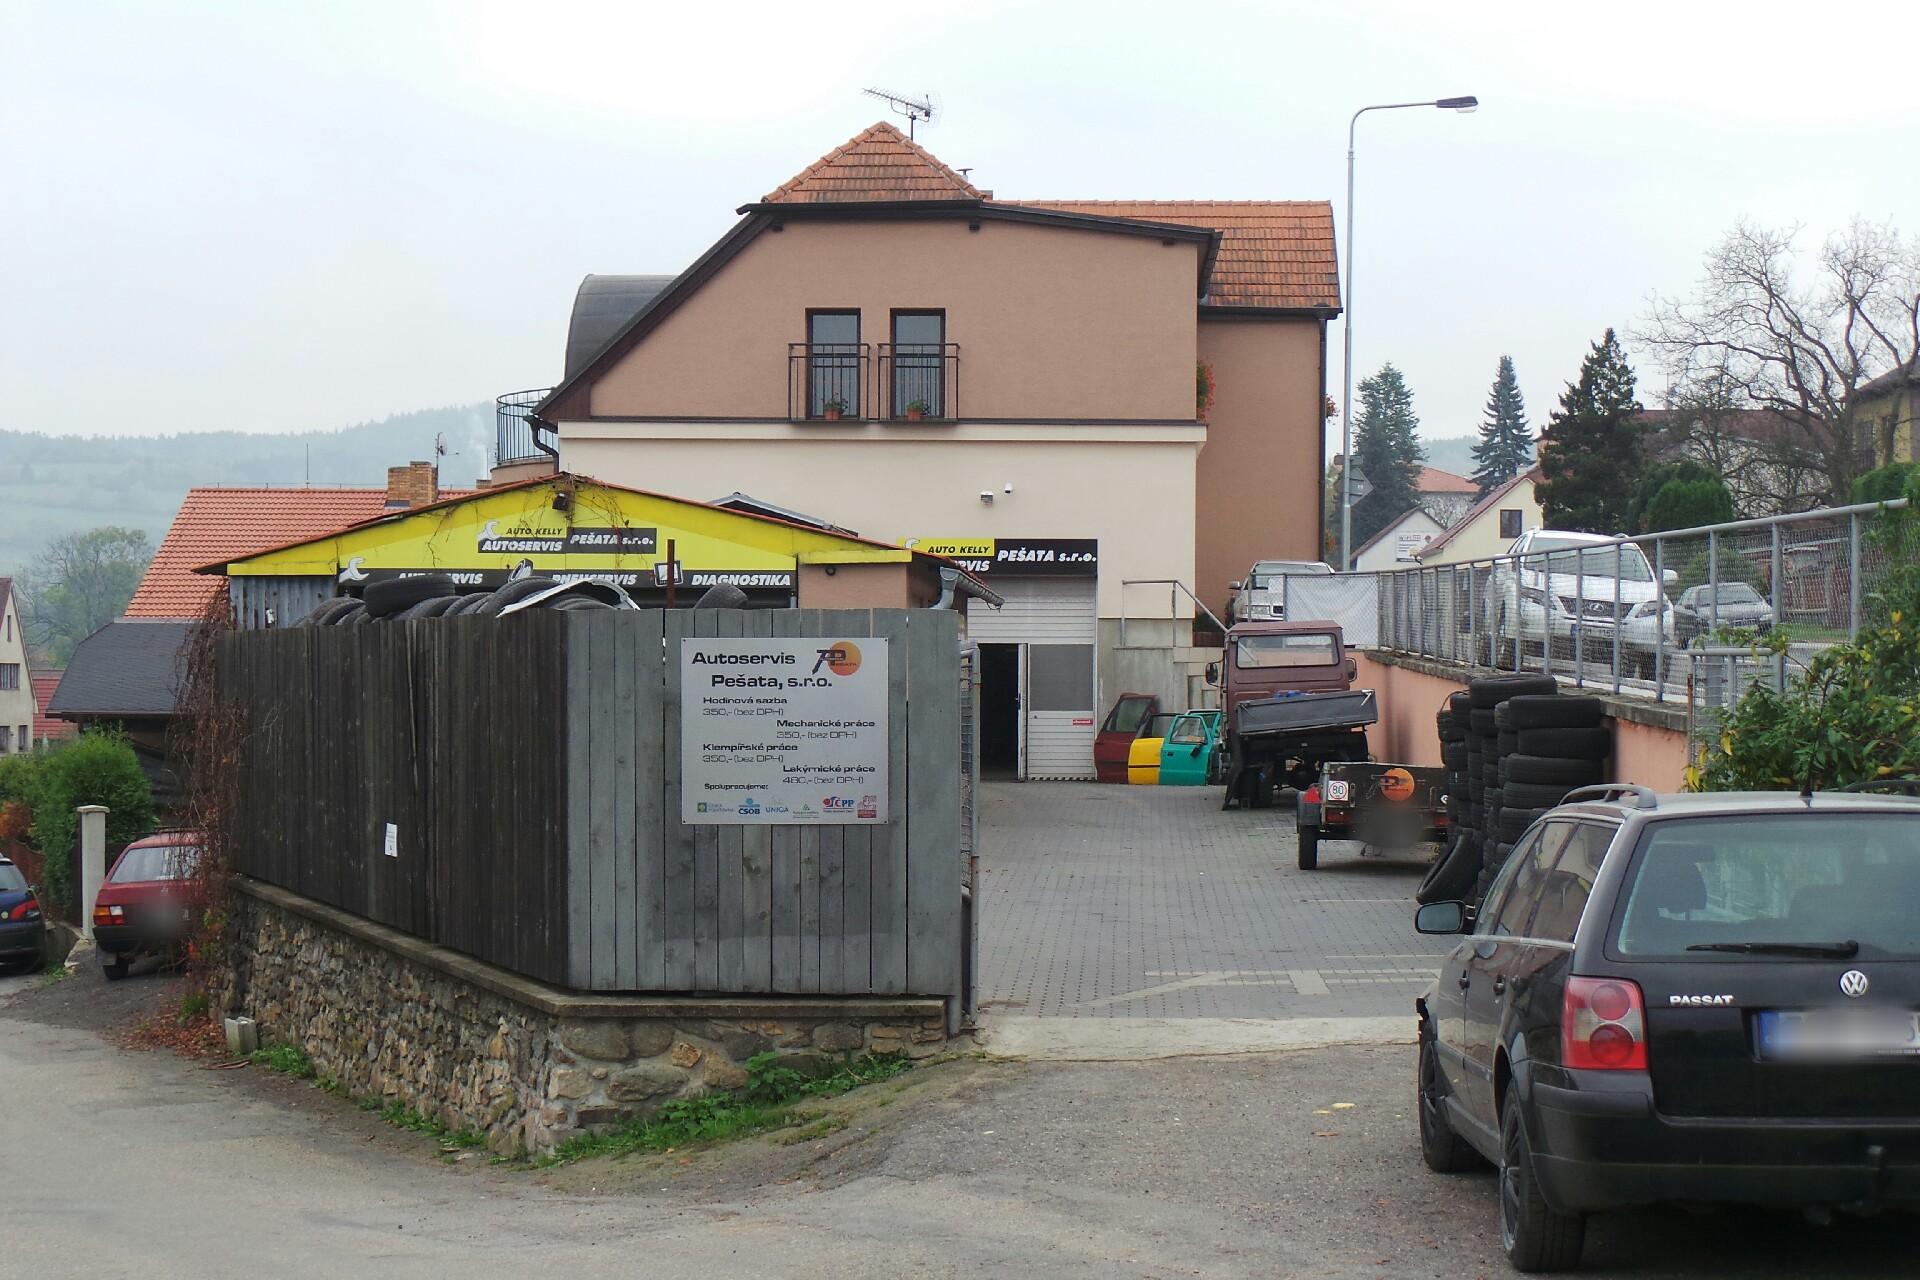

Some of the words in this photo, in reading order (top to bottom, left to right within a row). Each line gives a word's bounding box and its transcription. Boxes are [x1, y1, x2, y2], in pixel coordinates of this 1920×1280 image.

[570, 532, 618, 545] PEŠATA
[622, 537, 654, 545] s.r.o.
[481, 540, 563, 551] AUTOSERVIS
[927, 546, 956, 554] AUTO
[959, 546, 991, 554] KELLY
[997, 547, 1055, 562] PEŠATA
[1058, 552, 1097, 563] s.r.o.
[691, 574, 791, 586] DIAGNOSTIKA
[691, 652, 796, 665] Autoservis
[711, 673, 783, 690] Pešata,
[787, 677, 833, 687] s.r.o.
[703, 696, 754, 704] Hodinová
[702, 708, 733, 716] 350,-
[733, 708, 755, 716] (bez
[756, 708, 784, 716] DPH)
[776, 719, 842, 728] Mechanické
[843, 719, 876, 728] práce
[776, 731, 807, 739] 350,-
[807, 731, 828, 739] (bez
[829, 731, 857, 739] DPH)
[702, 743, 764, 752] Klempířské
[766, 743, 798, 752] práce
[733, 755, 755, 763] (bez
[756, 755, 784, 763] DPH)
[843, 765, 876, 774] práce
[814, 776, 835, 784] (bez
[836, 776, 864, 784] DPH)
[704, 783, 769, 791] Spolupracujeme:
[1332, 785, 1344, 795] 80
[1669, 995, 1735, 1006] PASSAT
